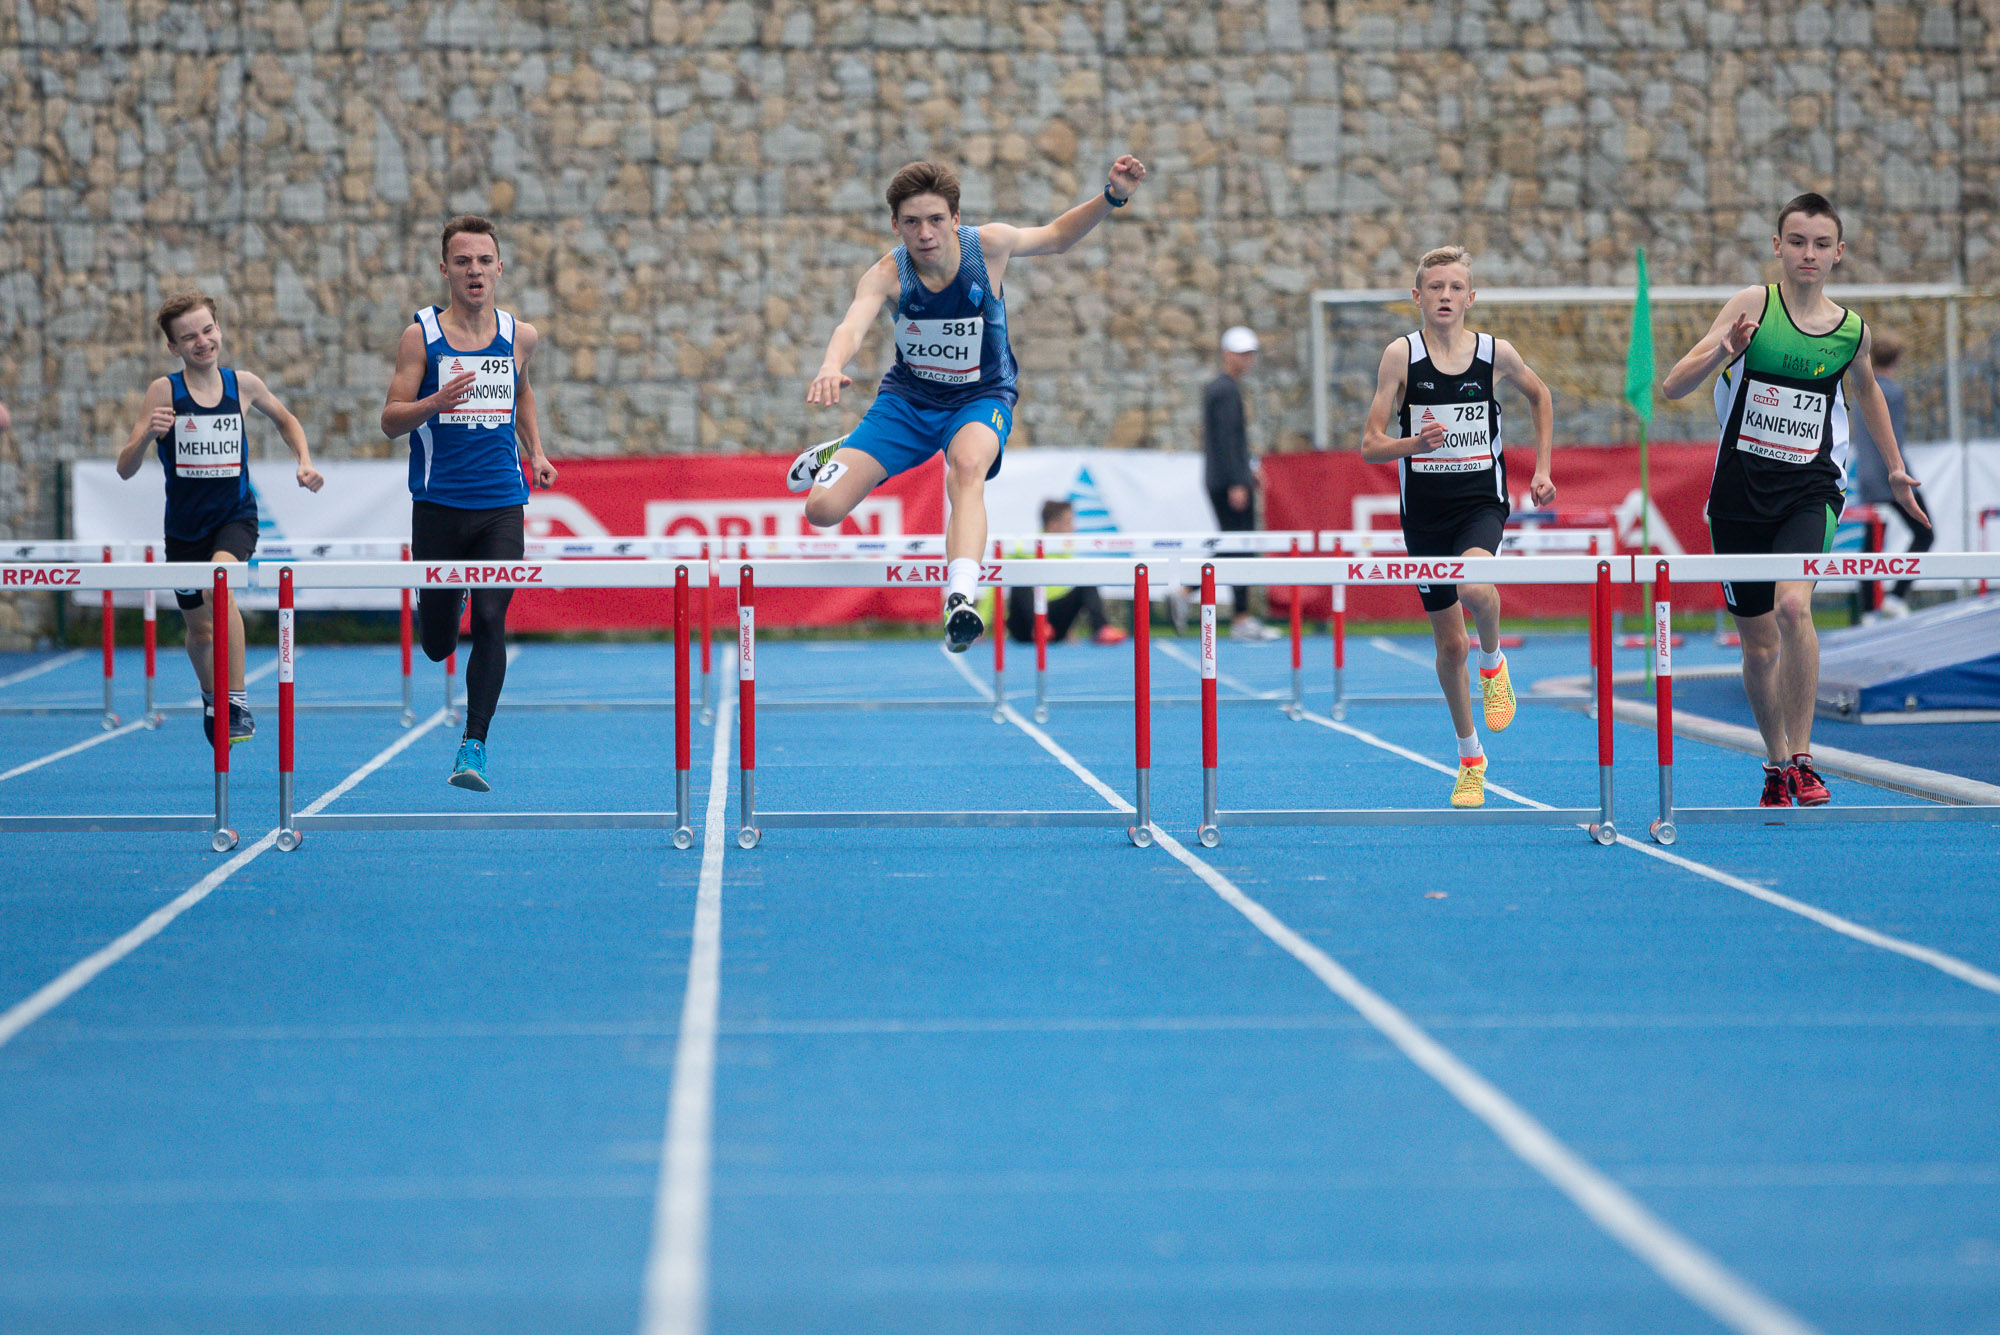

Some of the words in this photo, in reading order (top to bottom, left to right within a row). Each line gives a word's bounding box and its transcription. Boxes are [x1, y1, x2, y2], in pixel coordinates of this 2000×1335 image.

[942, 322, 977, 336] 581
[906, 343, 968, 360] ZŁOCH
[481, 360, 509, 374] 495
[912, 369, 946, 382] ARPACZ
[948, 375, 967, 383] 2021
[1754, 395, 1778, 406] ORLEN
[1793, 393, 1822, 413] 171
[1454, 405, 1484, 422] 782
[213, 418, 238, 431] 491
[1745, 409, 1820, 440] KANIEWSKI
[178, 440, 239, 455] MEHLICH
[1415, 430, 1487, 448] KOWIAK
[1749, 444, 1786, 460] KARPACZ
[1788, 453, 1807, 463] 2021
[818, 463, 839, 483] 3
[1423, 463, 1461, 472] KARPACZ
[1463, 462, 1481, 470] 2021
[1, 569, 81, 585] RPACZ
[283, 626, 291, 664] polanik
[743, 625, 751, 661] polanik
[1206, 623, 1214, 660] polanik
[1660, 619, 1668, 657] polanik
